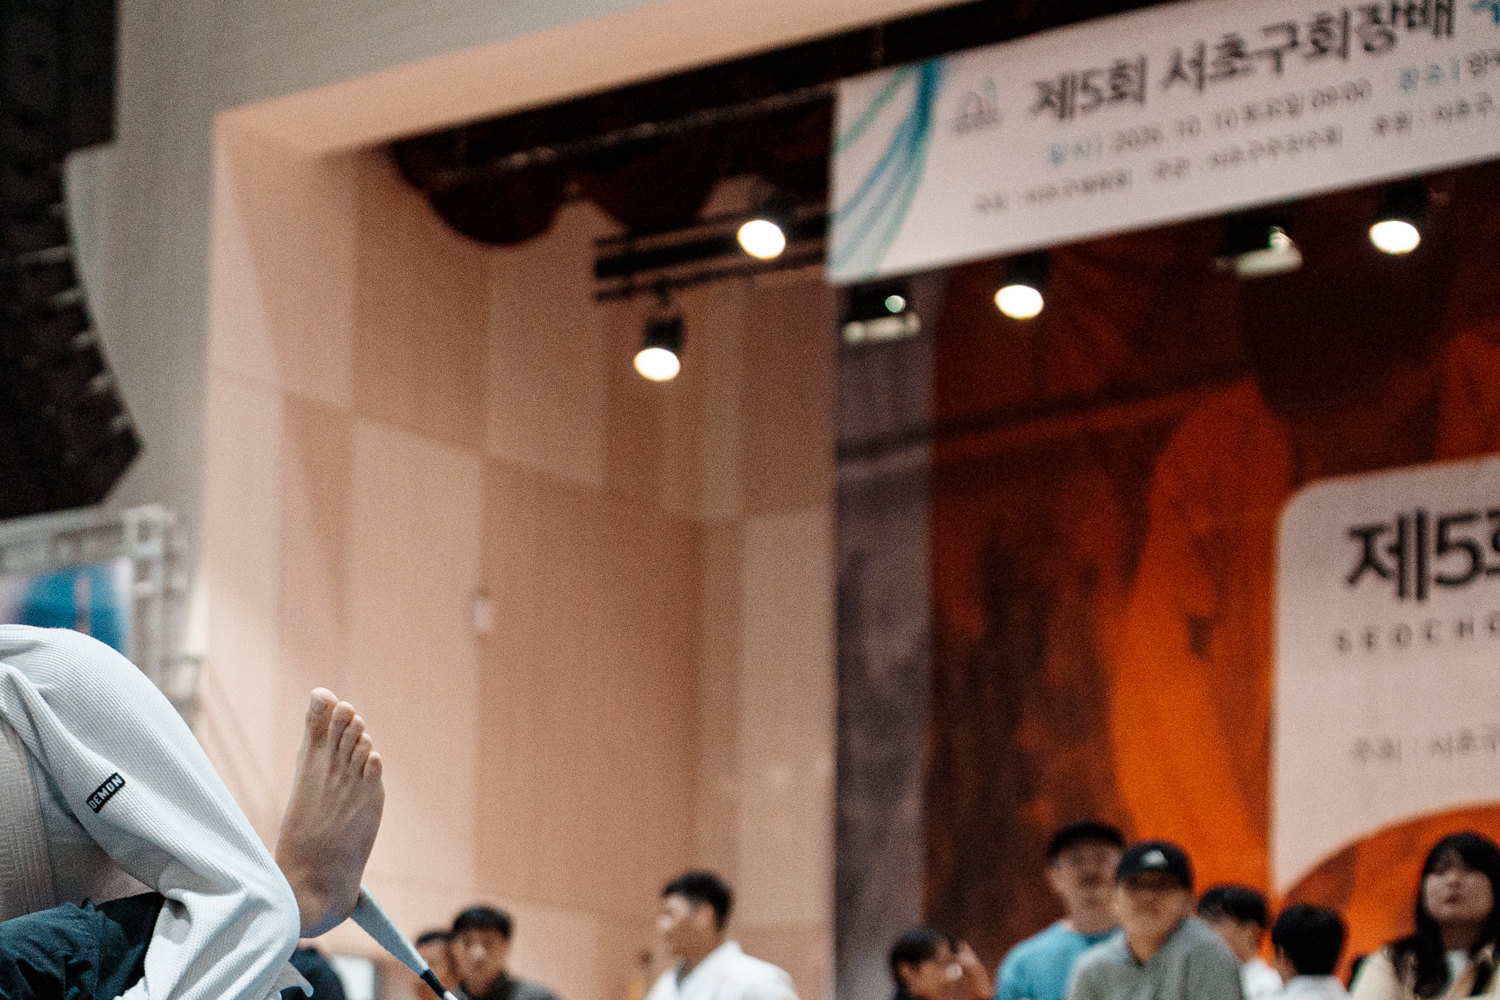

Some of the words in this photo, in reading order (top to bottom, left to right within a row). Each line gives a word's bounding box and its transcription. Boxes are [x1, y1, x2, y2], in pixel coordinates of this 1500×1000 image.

[1028, 52, 1148, 119] 제5회
[1346, 508, 1500, 602] 제5
[88, 774, 124, 810] DEMON
